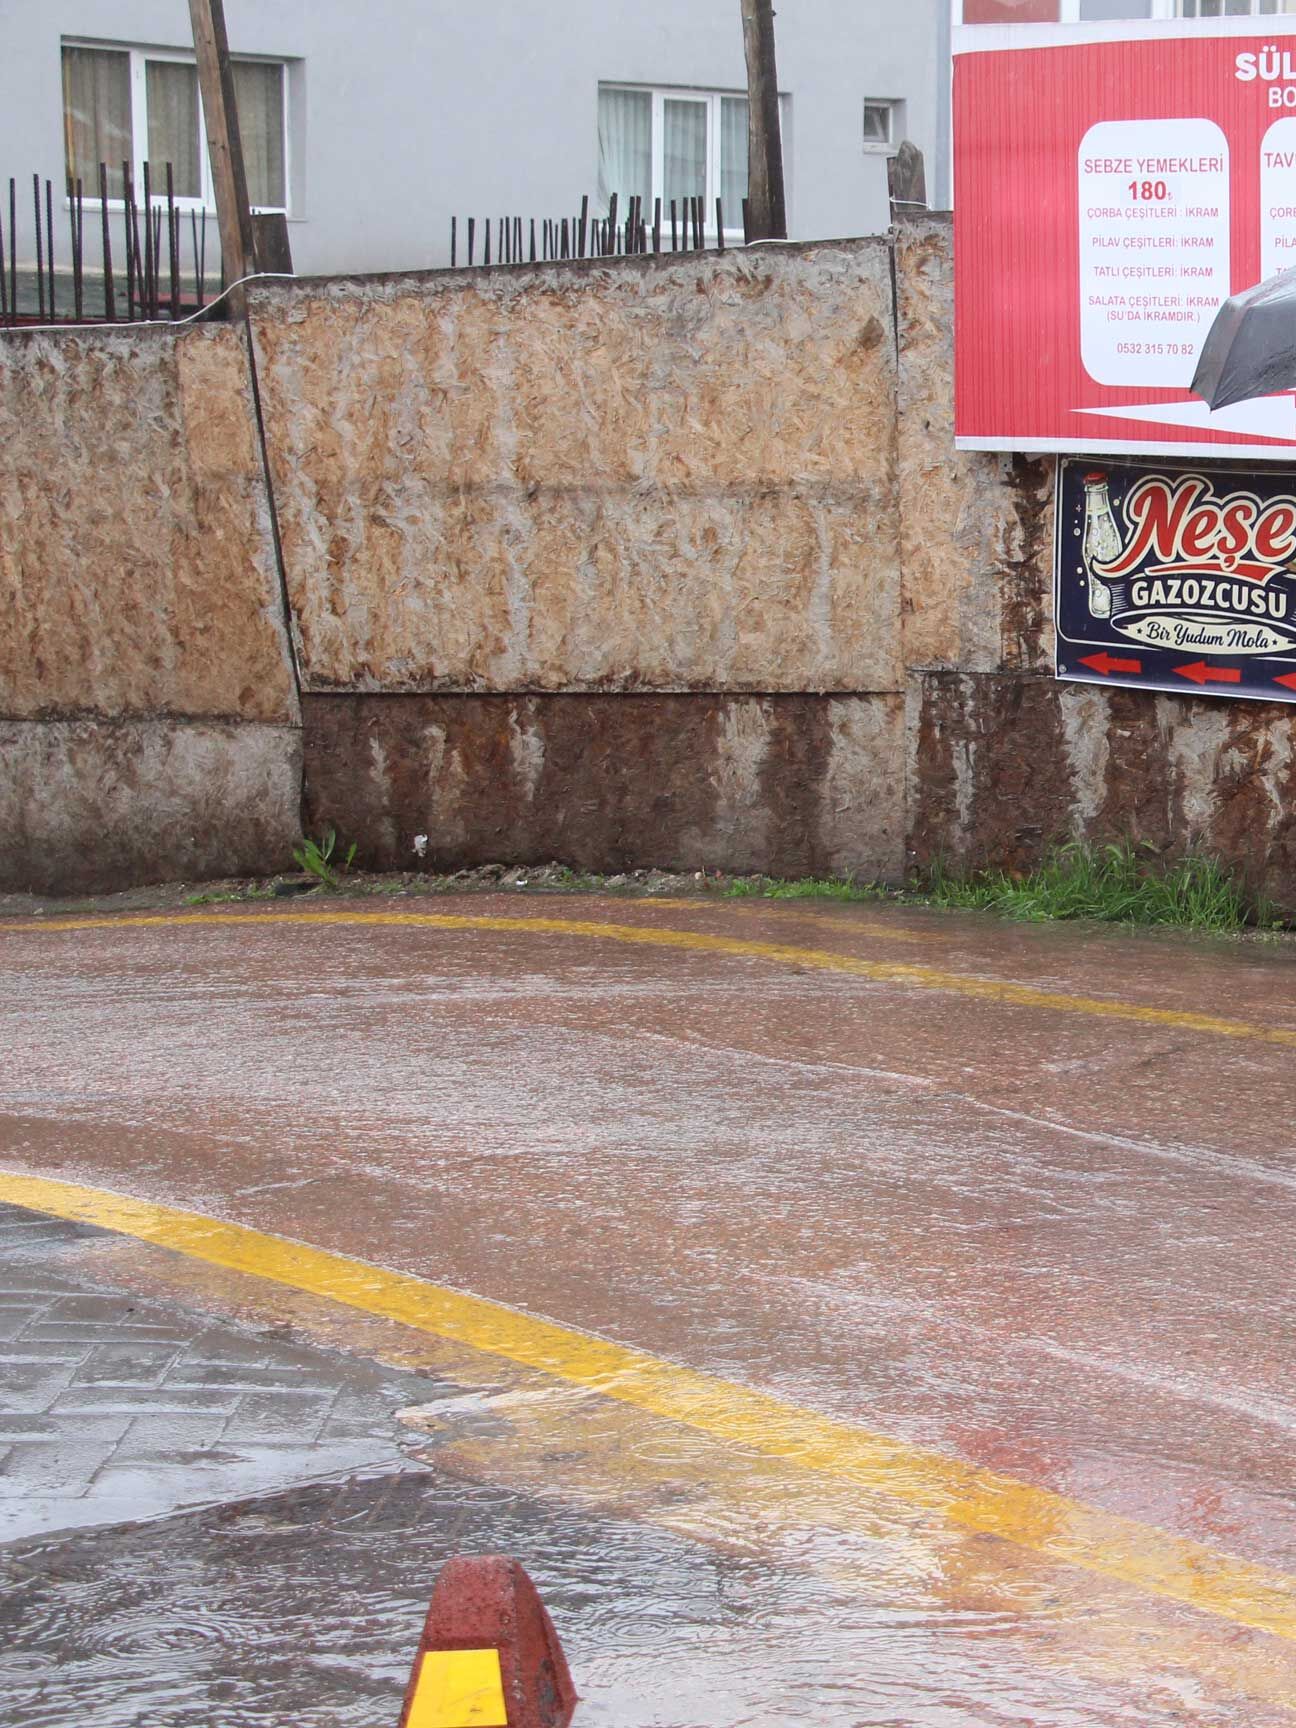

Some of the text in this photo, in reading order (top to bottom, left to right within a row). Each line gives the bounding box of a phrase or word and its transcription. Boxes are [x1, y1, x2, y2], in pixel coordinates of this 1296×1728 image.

[1084, 153, 1223, 174] SEBZE YEMEKLERİ
[1087, 207, 1122, 220] ÇORBA
[1185, 204, 1219, 217] İKRAM
[1092, 235, 1121, 248] PİLAV
[1181, 235, 1214, 248] İKRAM
[1094, 266, 1120, 277] TATLI
[1180, 264, 1213, 277] İKRAM
[1088, 296, 1126, 306] SALATA
[1186, 295, 1219, 307] İKRAM
[1117, 343, 1194, 355] 0532 315 70 82
[1132, 579, 1287, 619] GAZOZCUSU
[1146, 620, 1269, 649] Bir Yudum Mola
